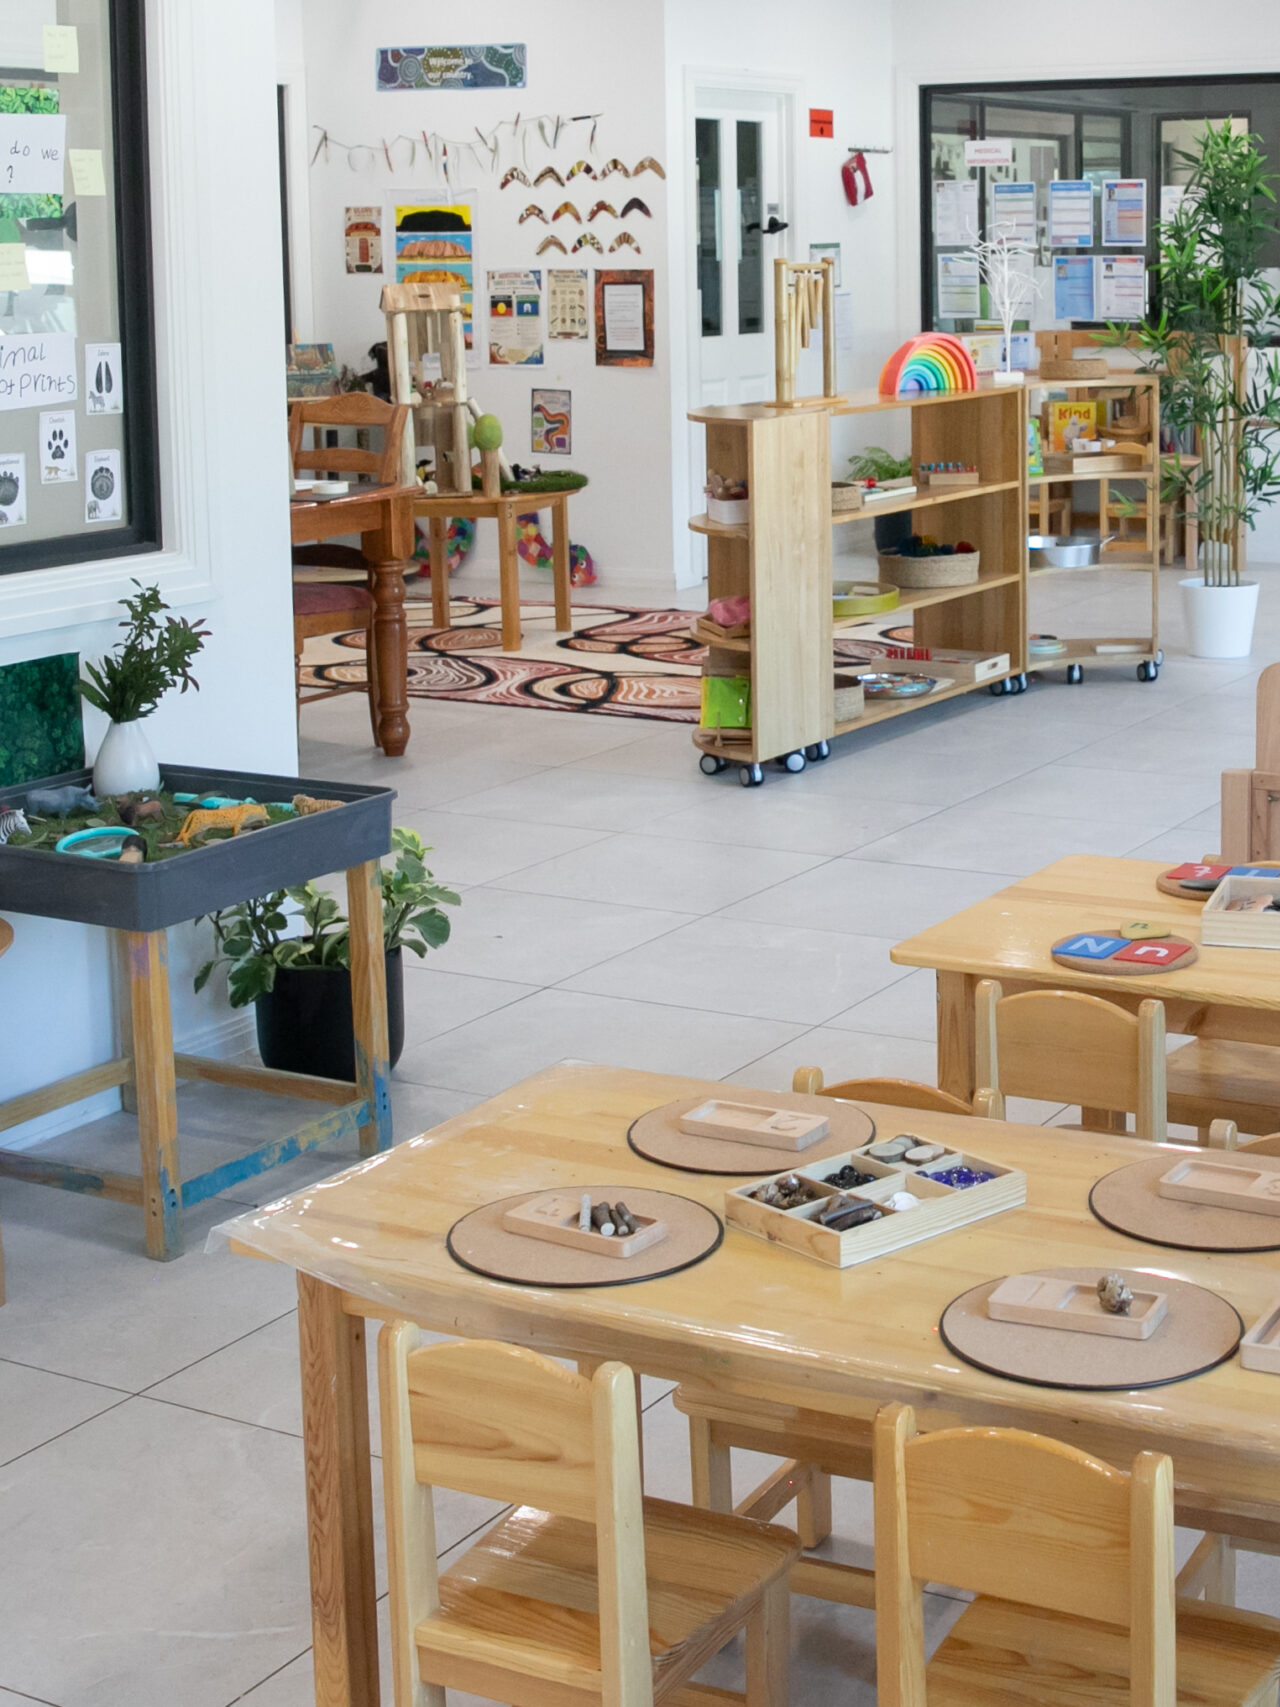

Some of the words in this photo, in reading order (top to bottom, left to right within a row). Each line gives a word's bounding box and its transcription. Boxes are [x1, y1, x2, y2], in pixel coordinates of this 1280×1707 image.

[428, 56, 464, 67] Welcome
[10, 140, 30, 157] do
[41, 147, 59, 161] we
[1058, 407, 1091, 420] Kind
